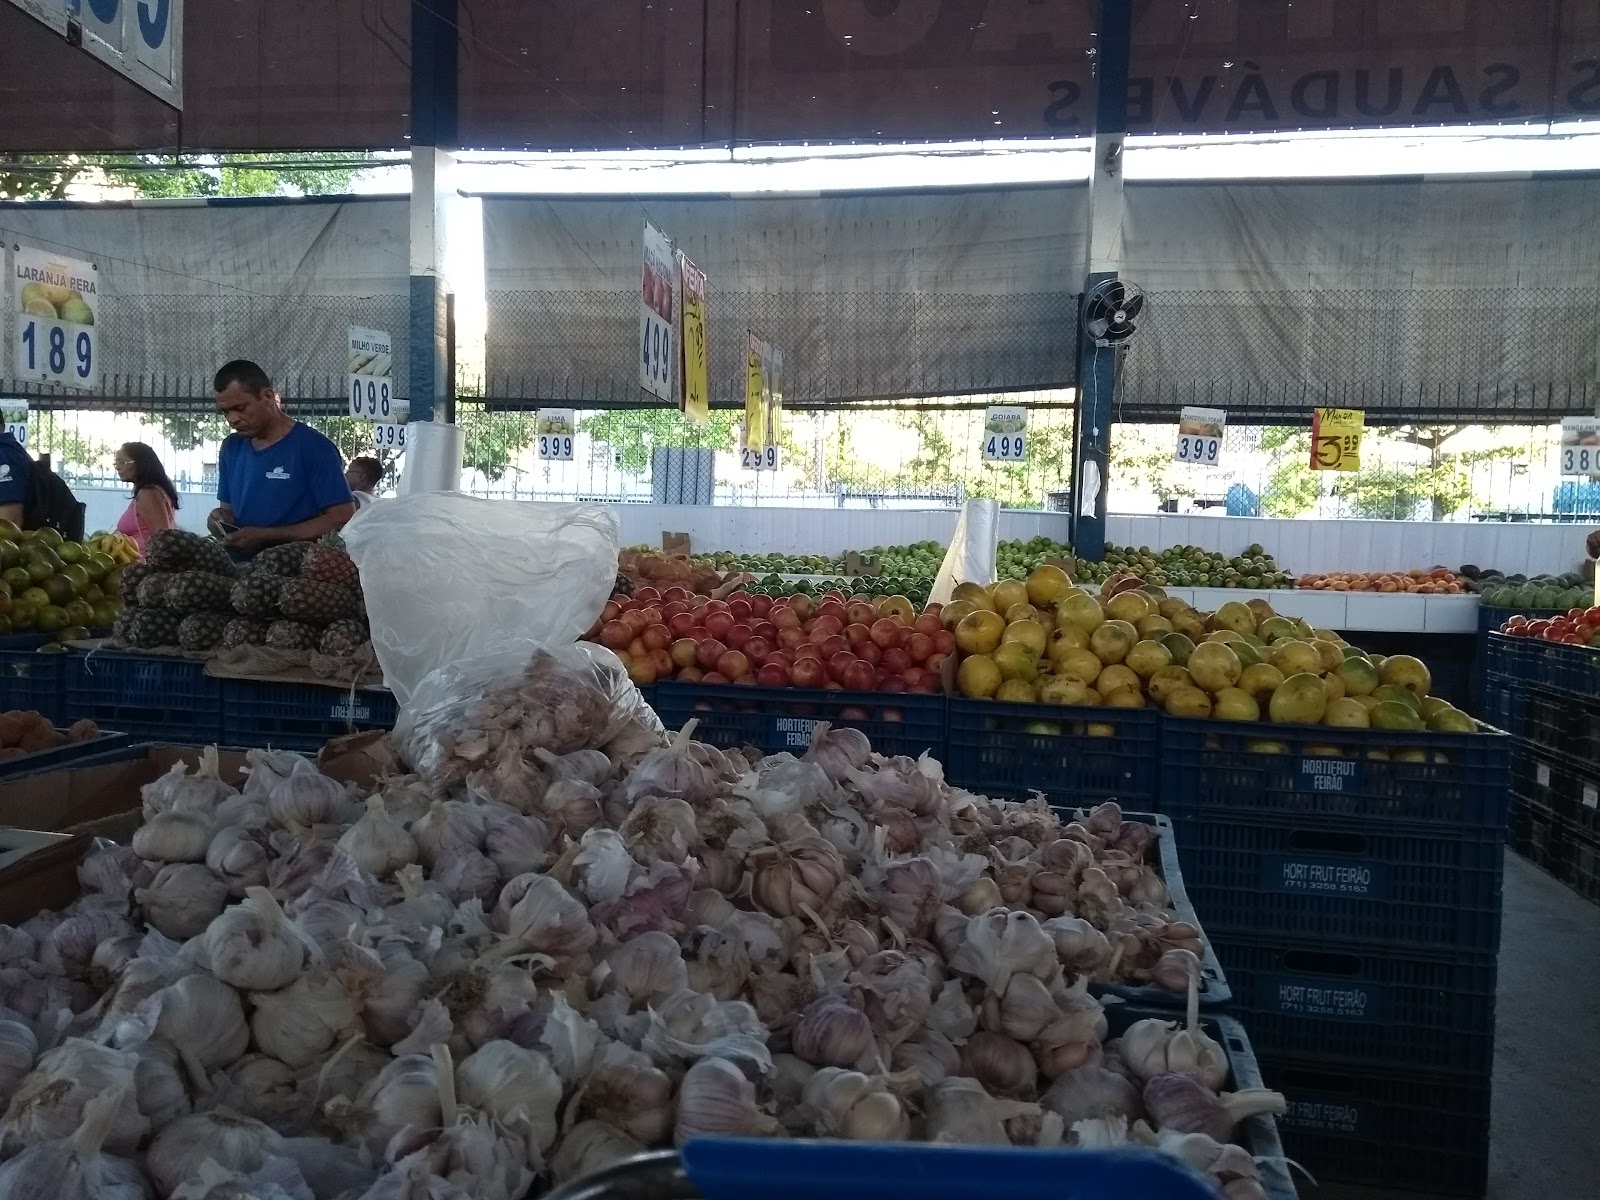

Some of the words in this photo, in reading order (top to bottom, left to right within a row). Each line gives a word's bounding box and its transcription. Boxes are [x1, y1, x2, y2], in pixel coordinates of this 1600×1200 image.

[17, 264, 67, 288] LARANJA
[69, 277, 97, 295] PERA
[351, 339, 370, 351] MILHO
[370, 342, 389, 354] VERDE
[992, 413, 1021, 421] GOIABA
[776, 718, 819, 732] HORTIFRU
[787, 731, 811, 746] FEIRÃO
[1302, 759, 1356, 776] HORTIFRUT
[1314, 774, 1343, 791] FEIRÃO
[1283, 863, 1309, 880] HORT
[1310, 864, 1335, 882] FRUT
[1336, 866, 1370, 885] FEIRÃO
[1284, 880, 1307, 889] (71)
[1279, 984, 1305, 1002] HORT
[1307, 987, 1332, 1006] FRUT
[1333, 989, 1367, 1009] FEIRÃO
[1297, 1102, 1323, 1120] FRUT
[1324, 1104, 1358, 1124] FEIRÃO
